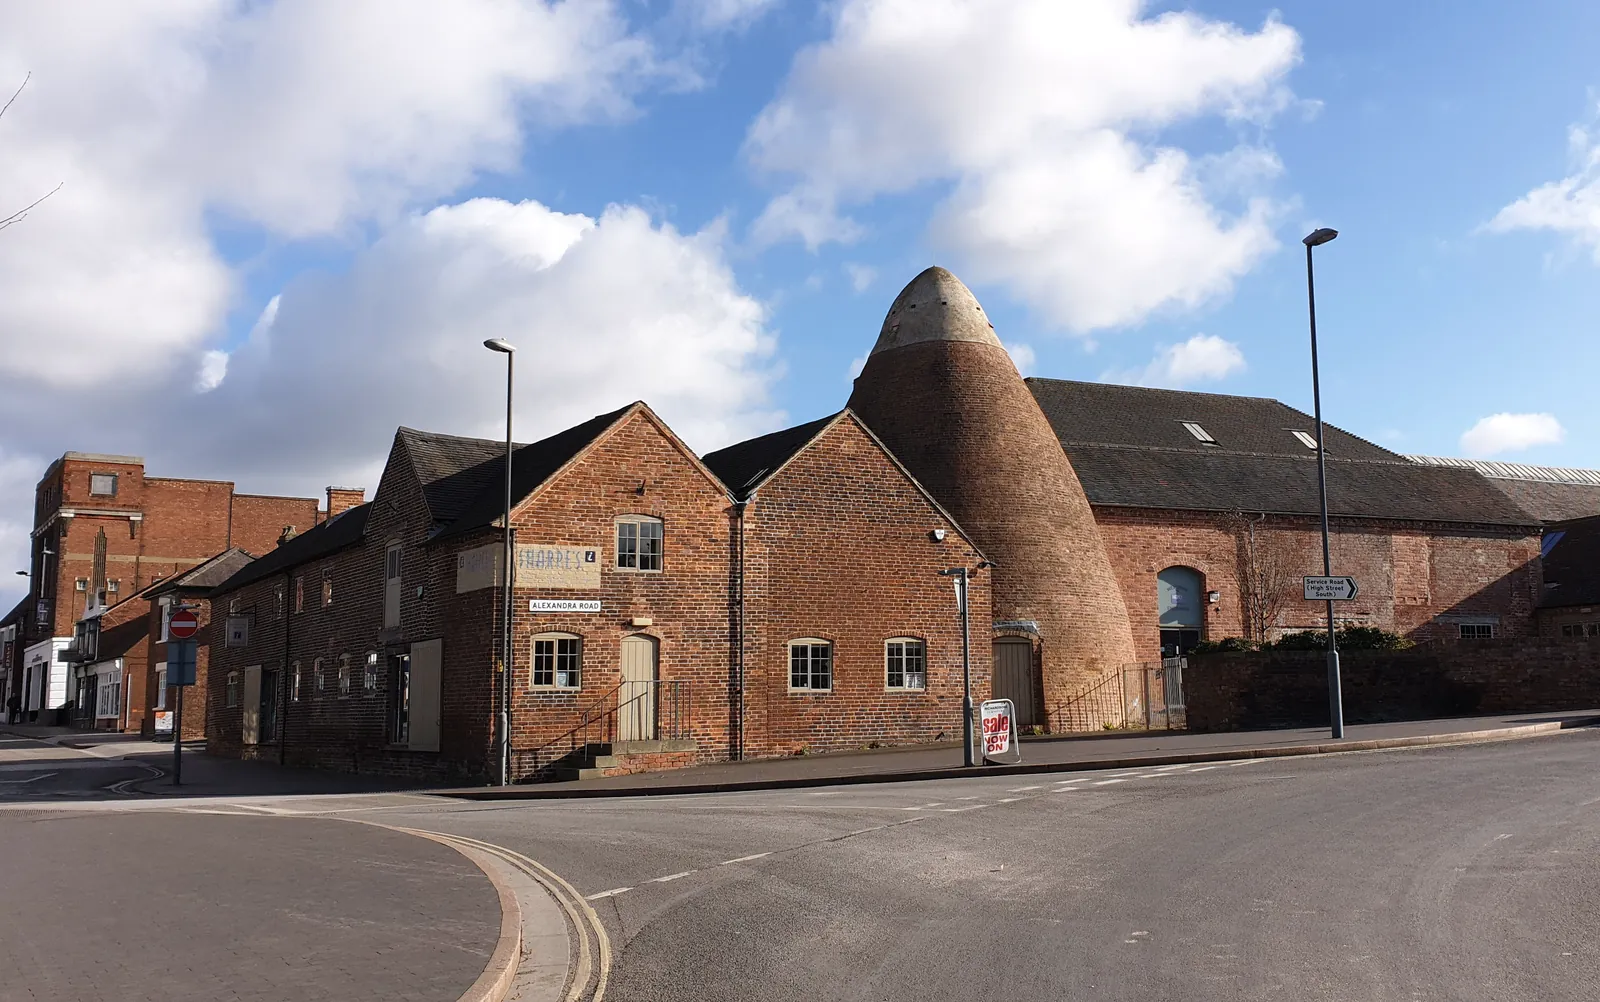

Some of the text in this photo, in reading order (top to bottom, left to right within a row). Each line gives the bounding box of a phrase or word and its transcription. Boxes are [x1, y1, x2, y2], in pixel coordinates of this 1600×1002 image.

[519, 549, 581, 569] SHARPE'S
[532, 602, 599, 610] ALEXANDRA ROAD
[983, 713, 1009, 733] sale
[987, 743, 1003, 752] ON
